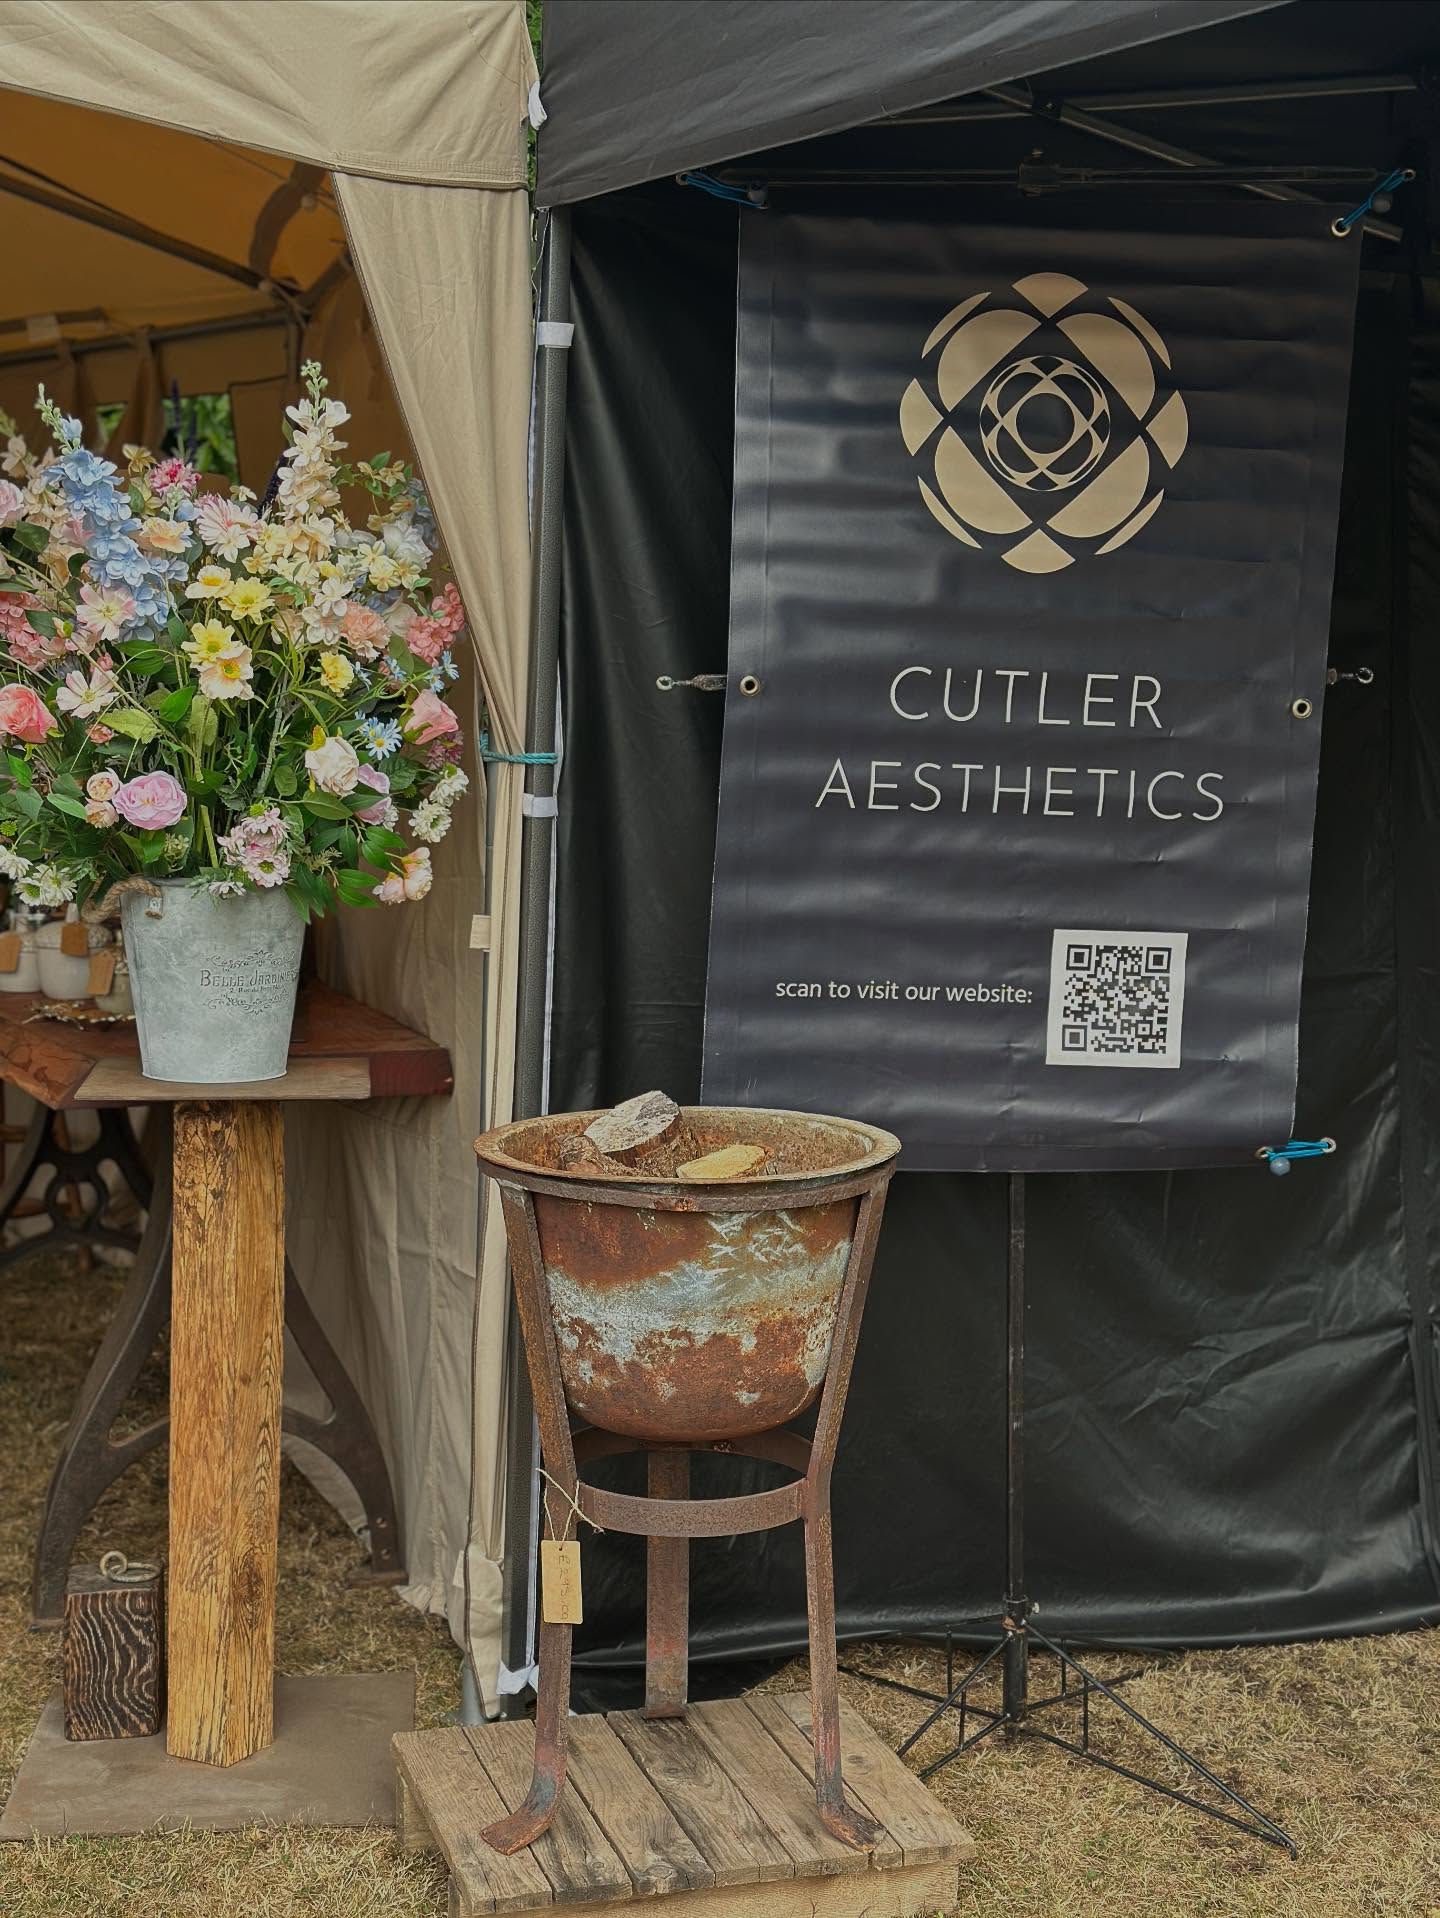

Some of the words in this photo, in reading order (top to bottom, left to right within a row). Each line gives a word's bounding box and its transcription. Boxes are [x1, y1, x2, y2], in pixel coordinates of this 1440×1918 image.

[889, 666, 1163, 729] CUTLER
[815, 757, 1225, 822] AESTHETICS
[200, 969, 245, 987] BELLE
[775, 982, 822, 998] scan
[828, 981, 851, 999] to
[857, 980, 900, 1000] visit
[905, 986, 941, 1001] our
[945, 983, 1033, 1004] website:
